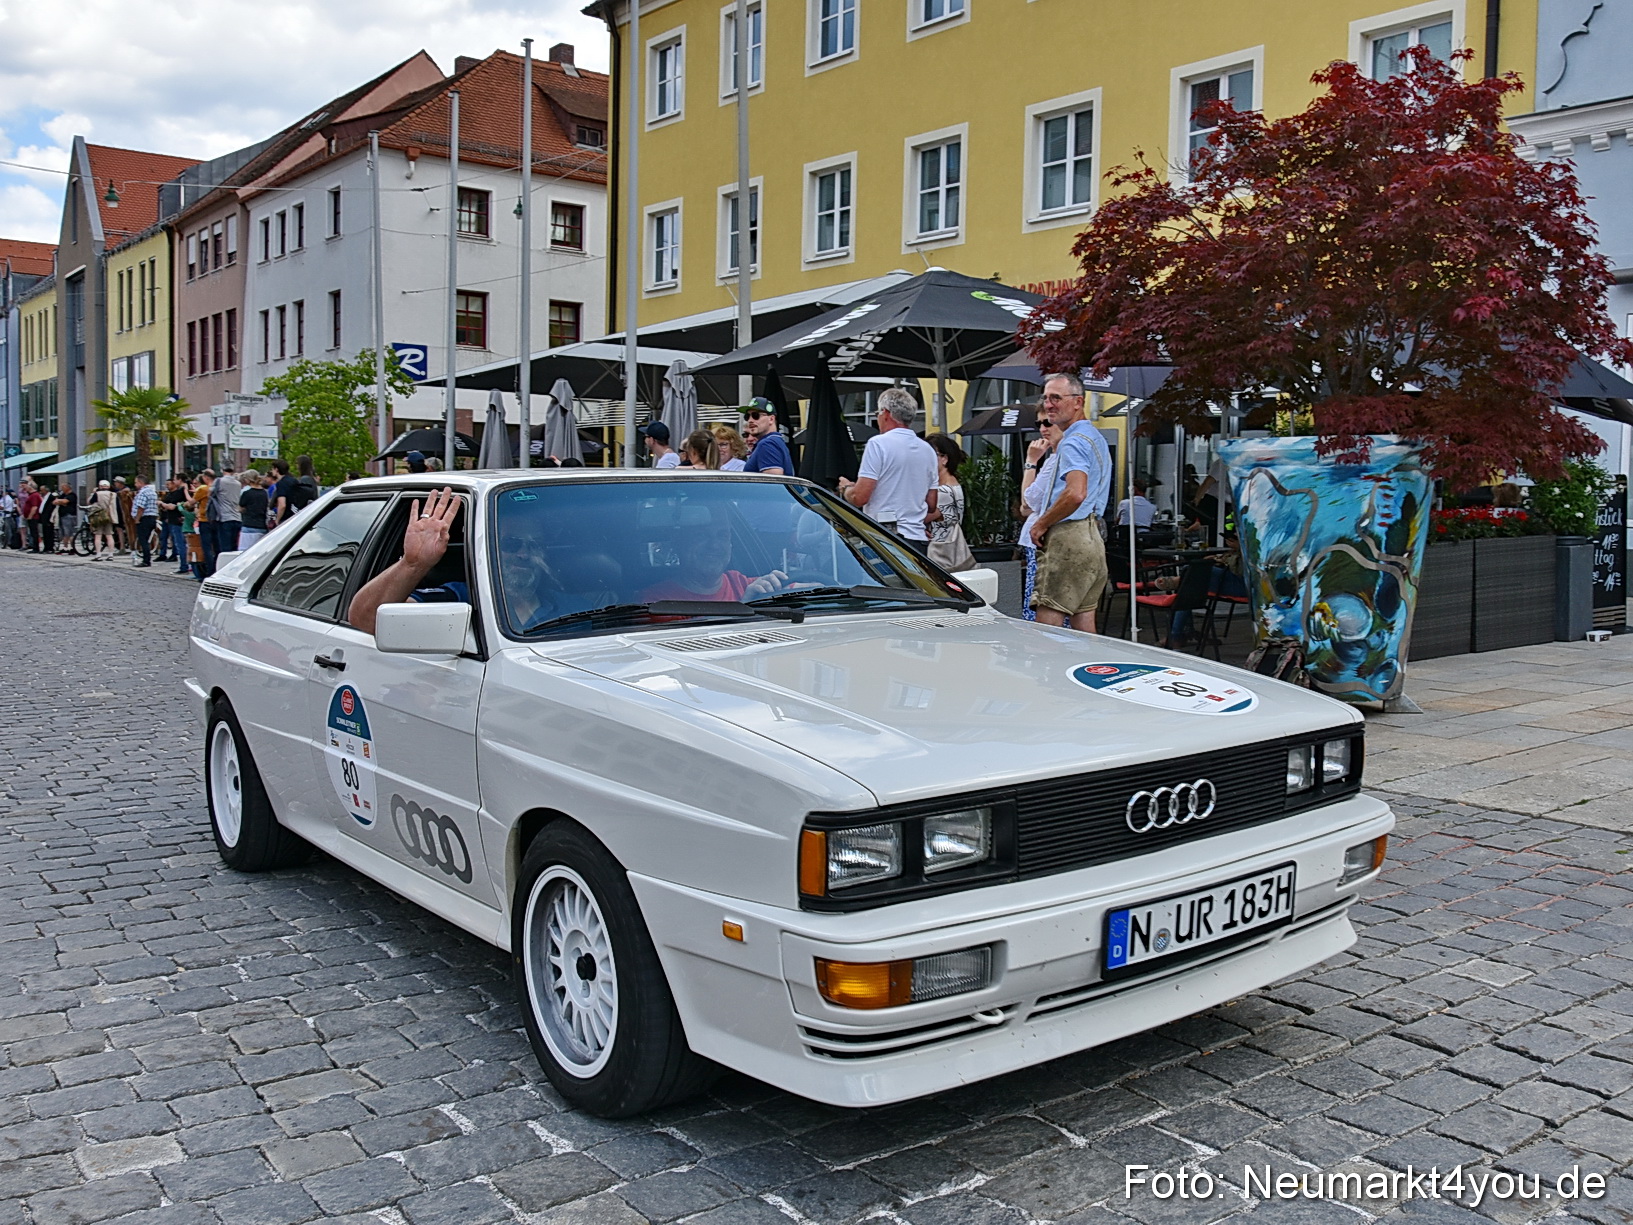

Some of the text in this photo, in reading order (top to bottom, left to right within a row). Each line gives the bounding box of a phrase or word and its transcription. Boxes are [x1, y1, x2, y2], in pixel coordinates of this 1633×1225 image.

[1028, 278, 1073, 297] RATHA
[1000, 409, 1020, 427] now
[1158, 681, 1209, 697] 80
[341, 757, 360, 791] 80
[1113, 871, 1293, 959] D N UR 183H
